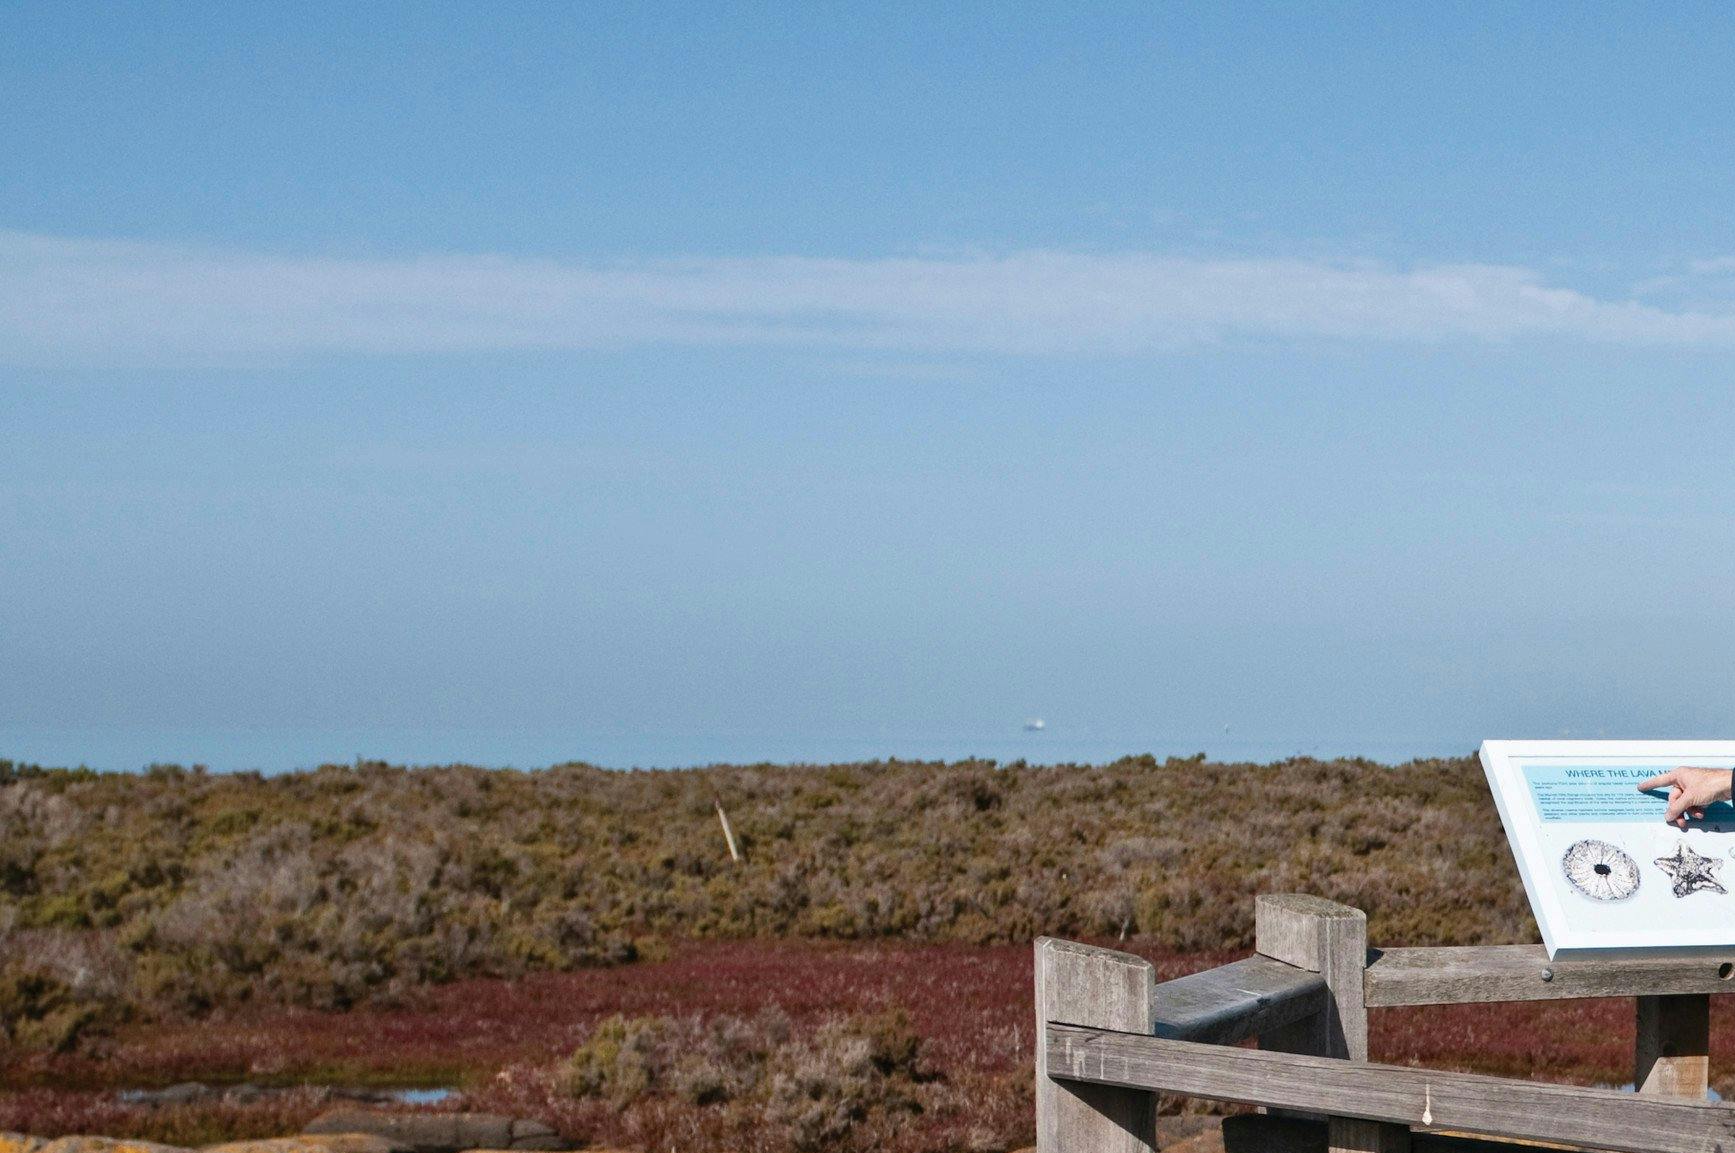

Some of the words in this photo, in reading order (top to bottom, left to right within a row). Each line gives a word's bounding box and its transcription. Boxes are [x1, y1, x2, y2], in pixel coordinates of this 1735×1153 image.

[1565, 769, 1605, 778] WHERE
[1607, 769, 1628, 778] THE
[1630, 769, 1657, 778] LAVA
